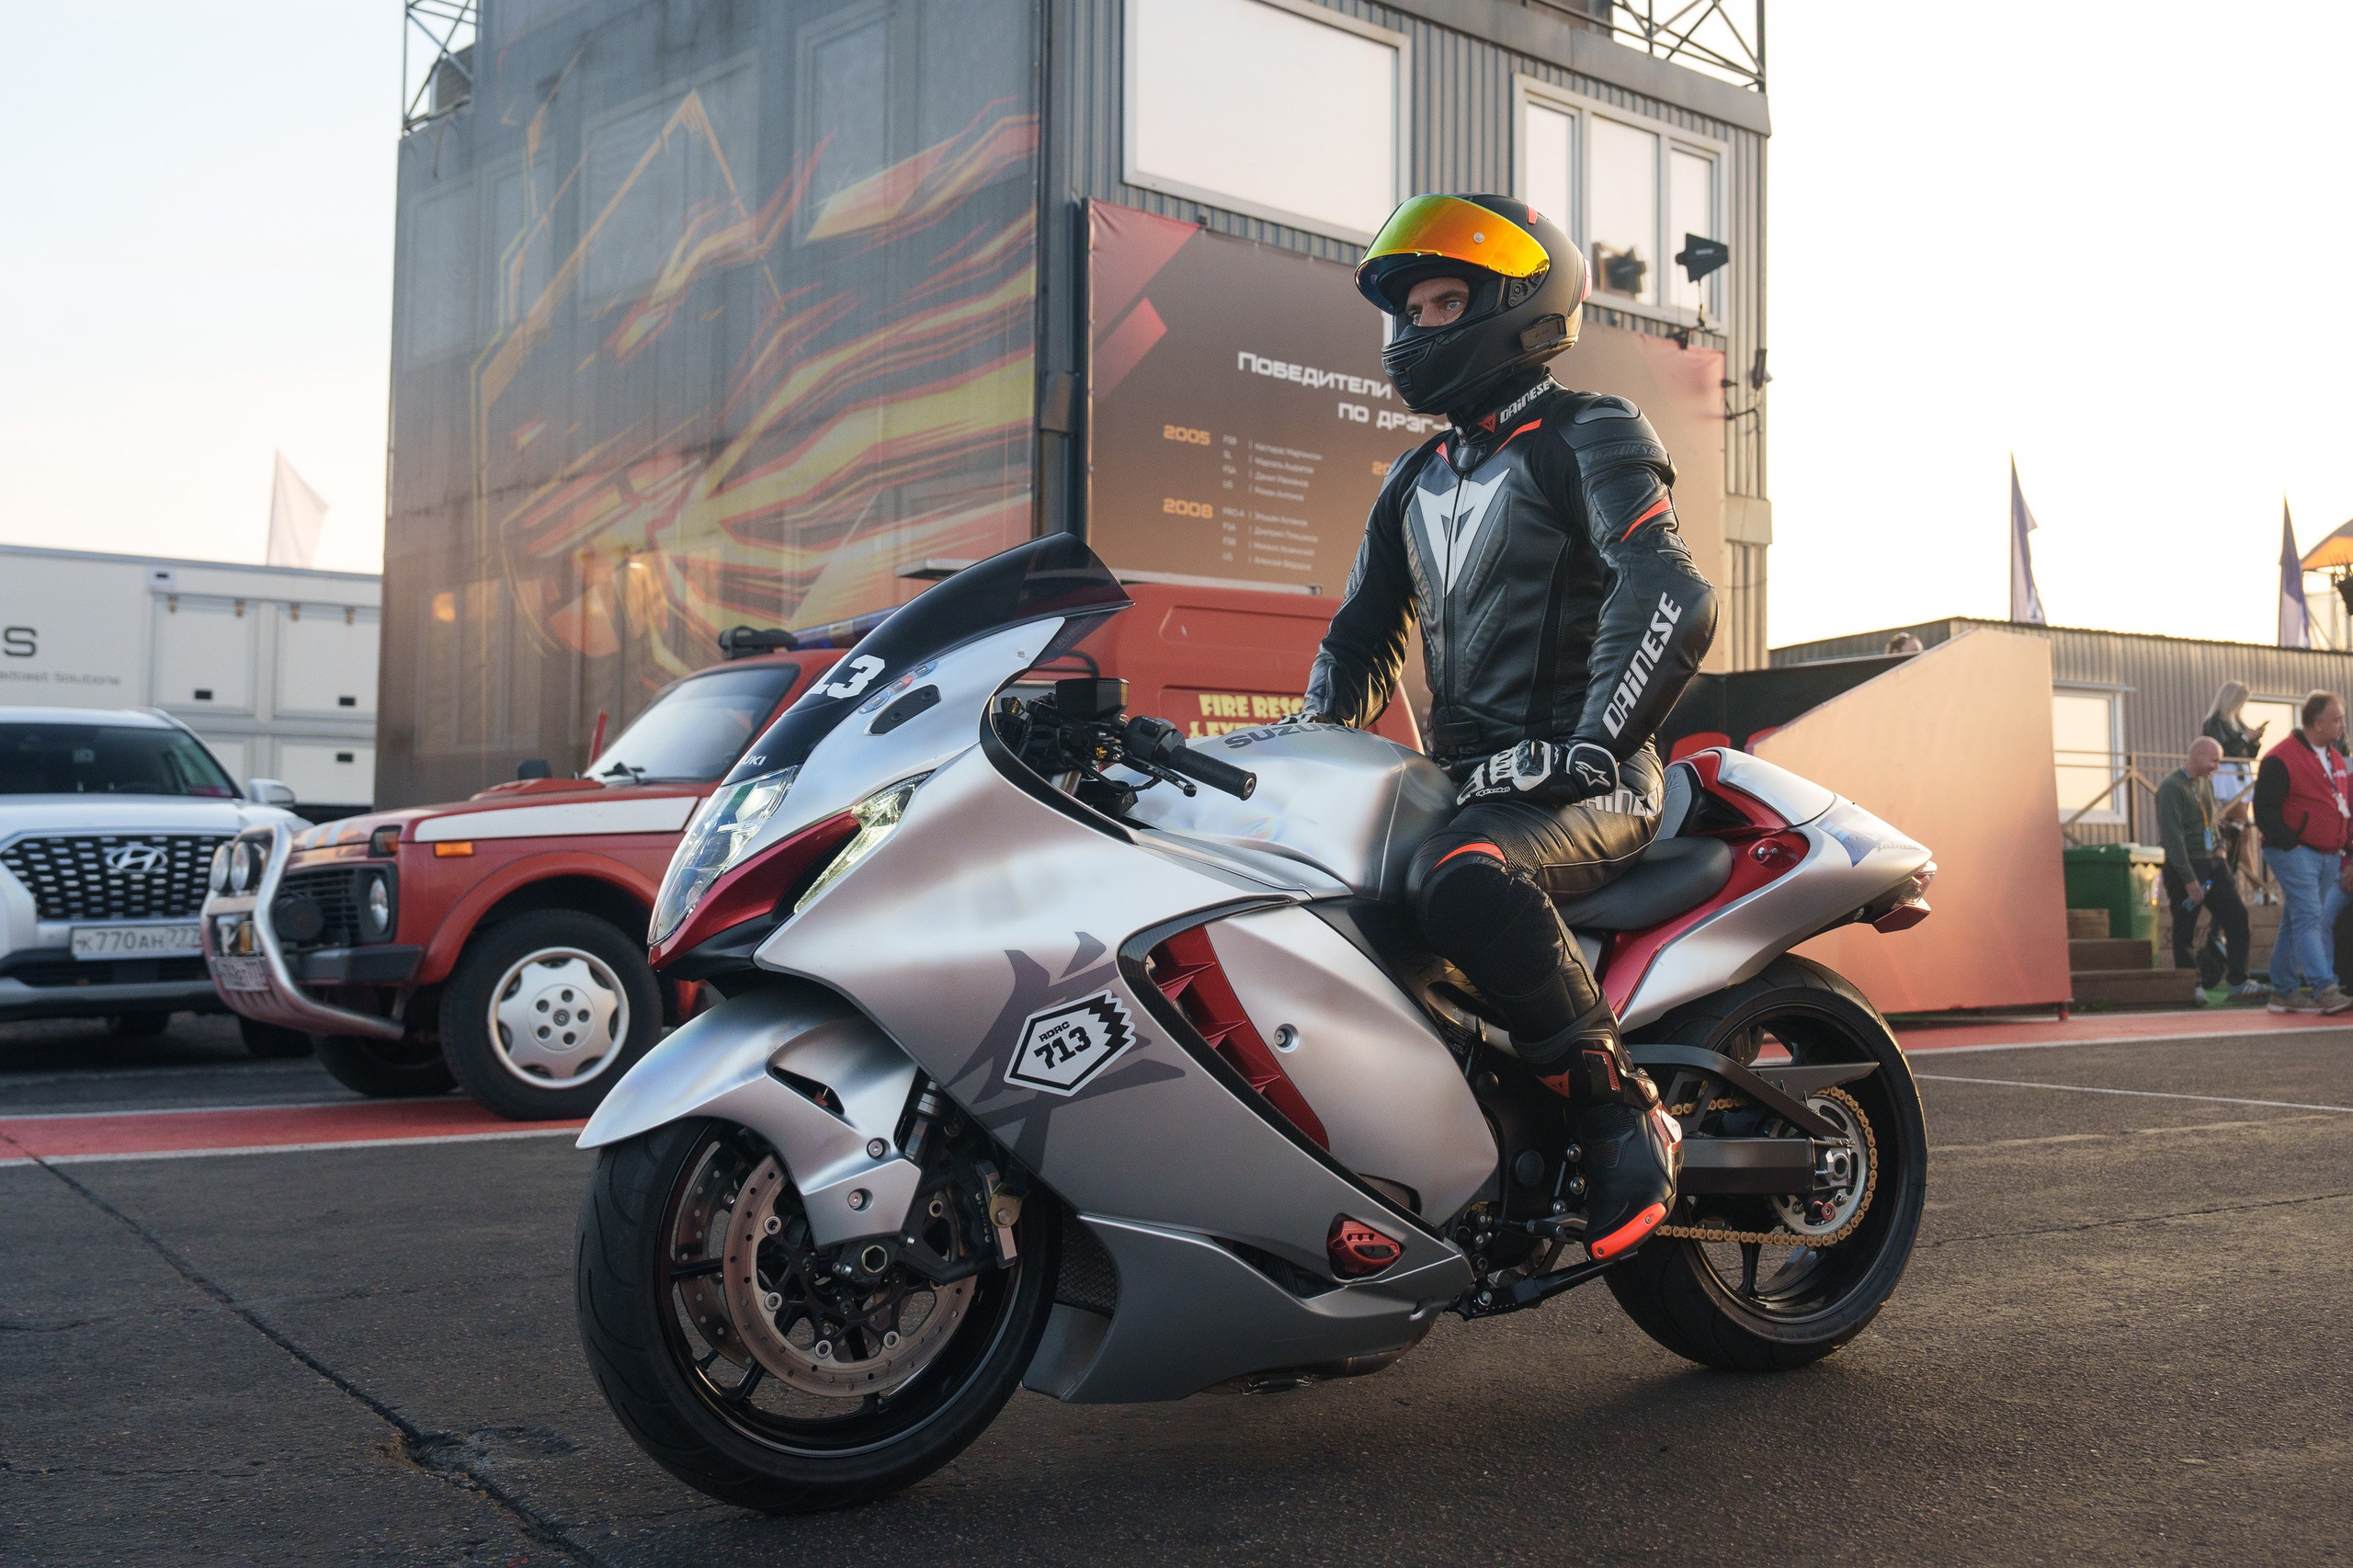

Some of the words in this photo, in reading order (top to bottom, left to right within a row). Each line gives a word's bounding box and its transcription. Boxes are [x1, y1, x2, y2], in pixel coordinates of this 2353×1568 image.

[1337, 402, 1370, 424] ПО
[1376, 409, 1452, 434] ДРЭГ-
[1163, 425, 1211, 446] 2005
[1163, 497, 1213, 519] 2008
[1199, 694, 1250, 718] FIRE
[1251, 696, 1304, 719] RESC
[1224, 723, 1357, 749] SUZUKI
[741, 755, 767, 766] UKI
[1038, 1020, 1071, 1043] RDRC
[1033, 1026, 1092, 1070] 713
